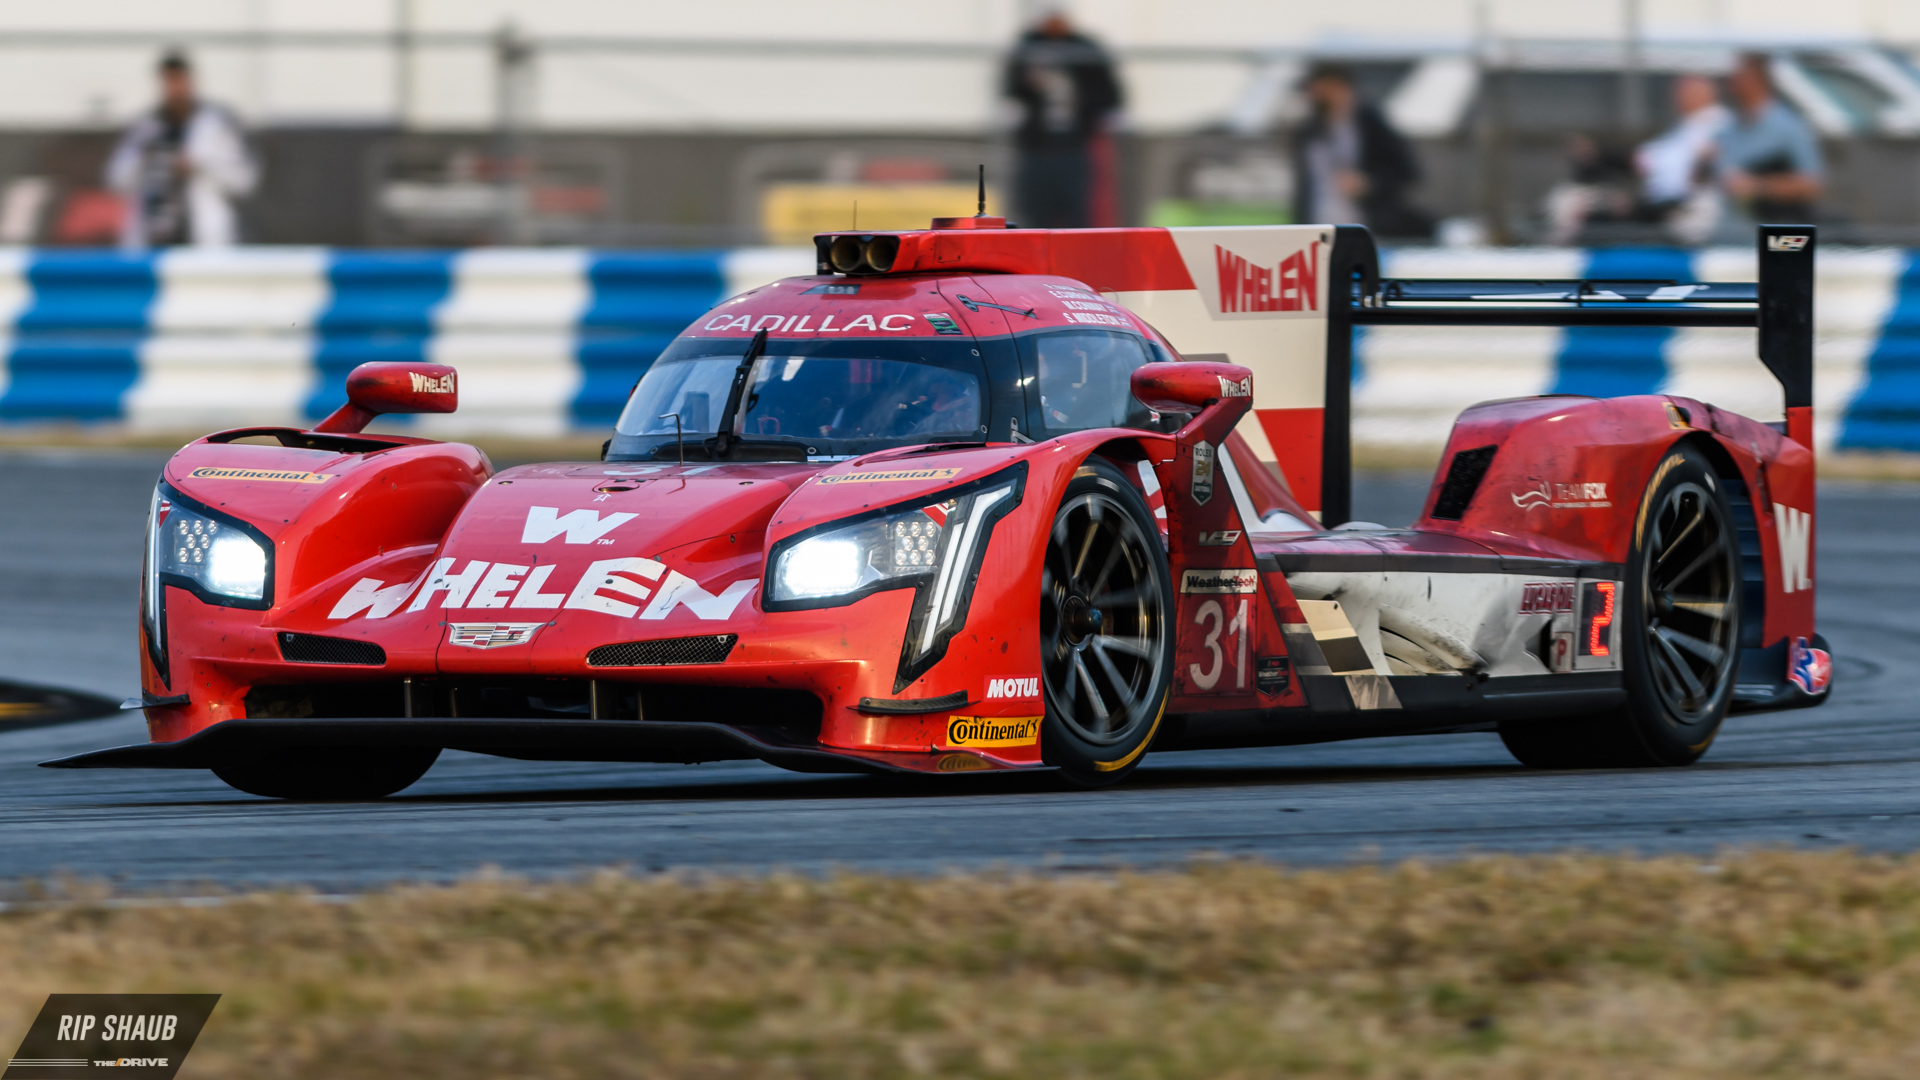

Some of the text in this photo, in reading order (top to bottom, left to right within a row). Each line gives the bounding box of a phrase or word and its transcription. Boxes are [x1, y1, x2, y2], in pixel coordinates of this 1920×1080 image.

[1214, 240, 1321, 313] WHELEN
[704, 313, 914, 332] CADILLAC
[409, 371, 455, 393] WHELEN
[1217, 375, 1252, 397] WHELEN
[1195, 448, 1213, 458] ROLEX
[192, 466, 315, 482] Continental
[820, 469, 939, 485] Continental
[521, 506, 640, 544] W
[327, 557, 760, 620] WHELEN
[1187, 576, 1254, 587] WeatherTech
[1591, 582, 1615, 657] 2
[1190, 599, 1248, 690] 31
[986, 677, 1040, 698] MOTUL
[949, 718, 1029, 744] Continental
